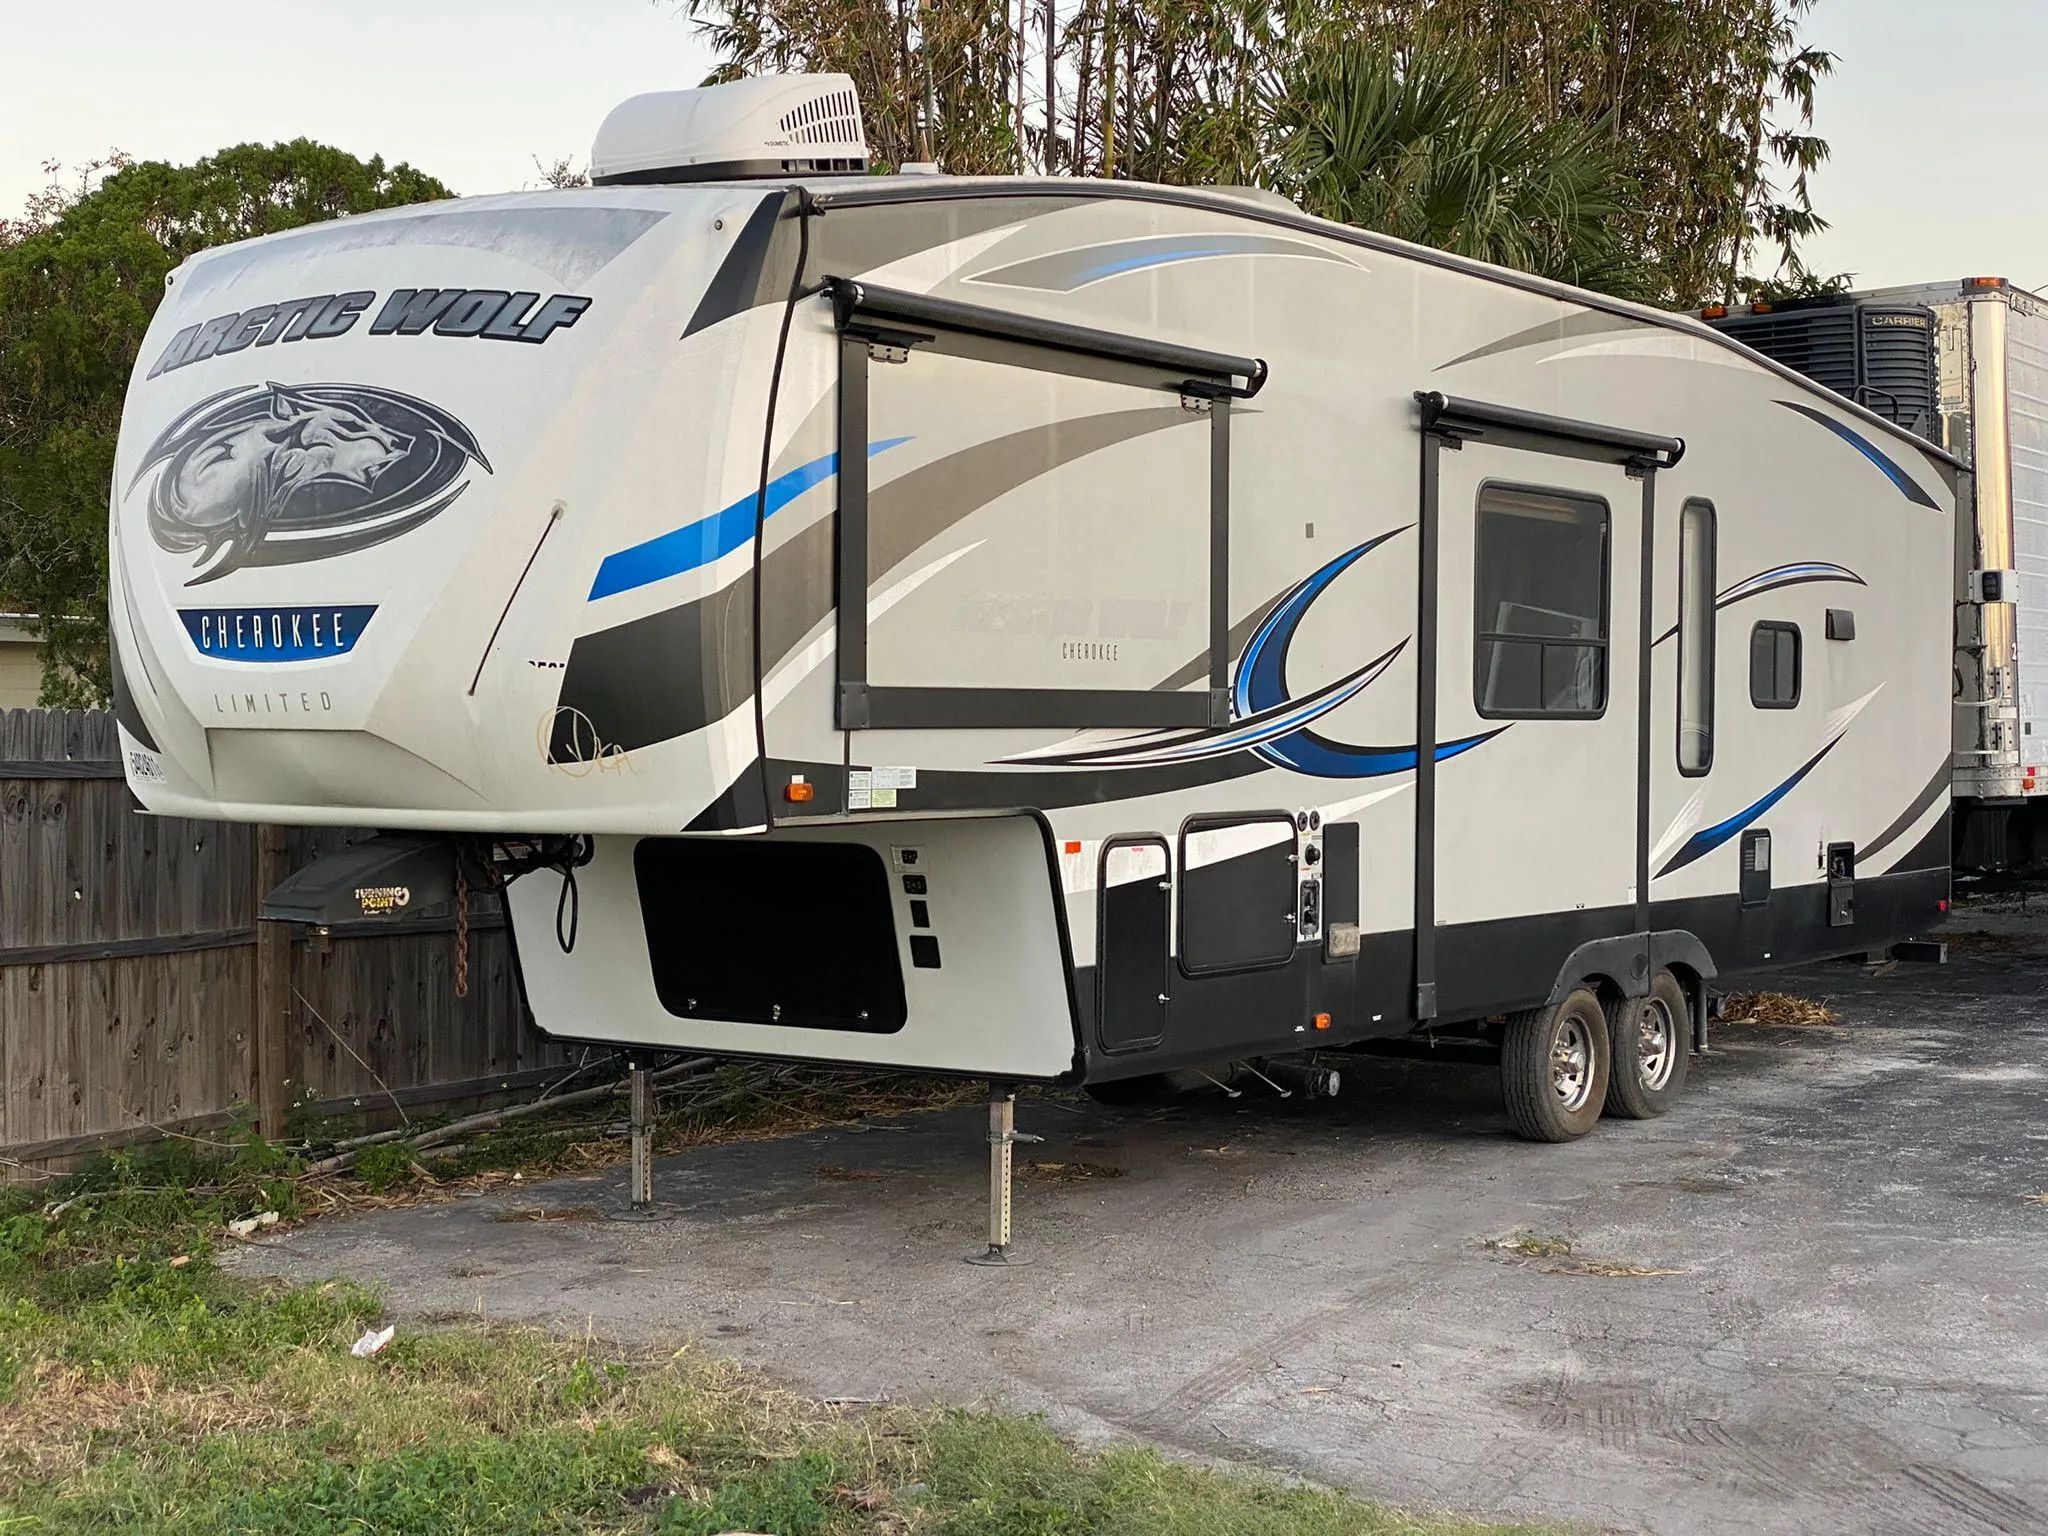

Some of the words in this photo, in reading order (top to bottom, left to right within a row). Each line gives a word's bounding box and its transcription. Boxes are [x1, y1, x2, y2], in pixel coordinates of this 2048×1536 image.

[1872, 316, 1926, 328] CARRIER
[146, 290, 376, 380] ARCTIC
[369, 288, 593, 345] WOLF
[201, 612, 344, 649] CHEROKEE
[1062, 642, 1118, 660] CHEROKEE
[214, 691, 332, 713] LIMITED
[361, 897, 395, 908] POINT
